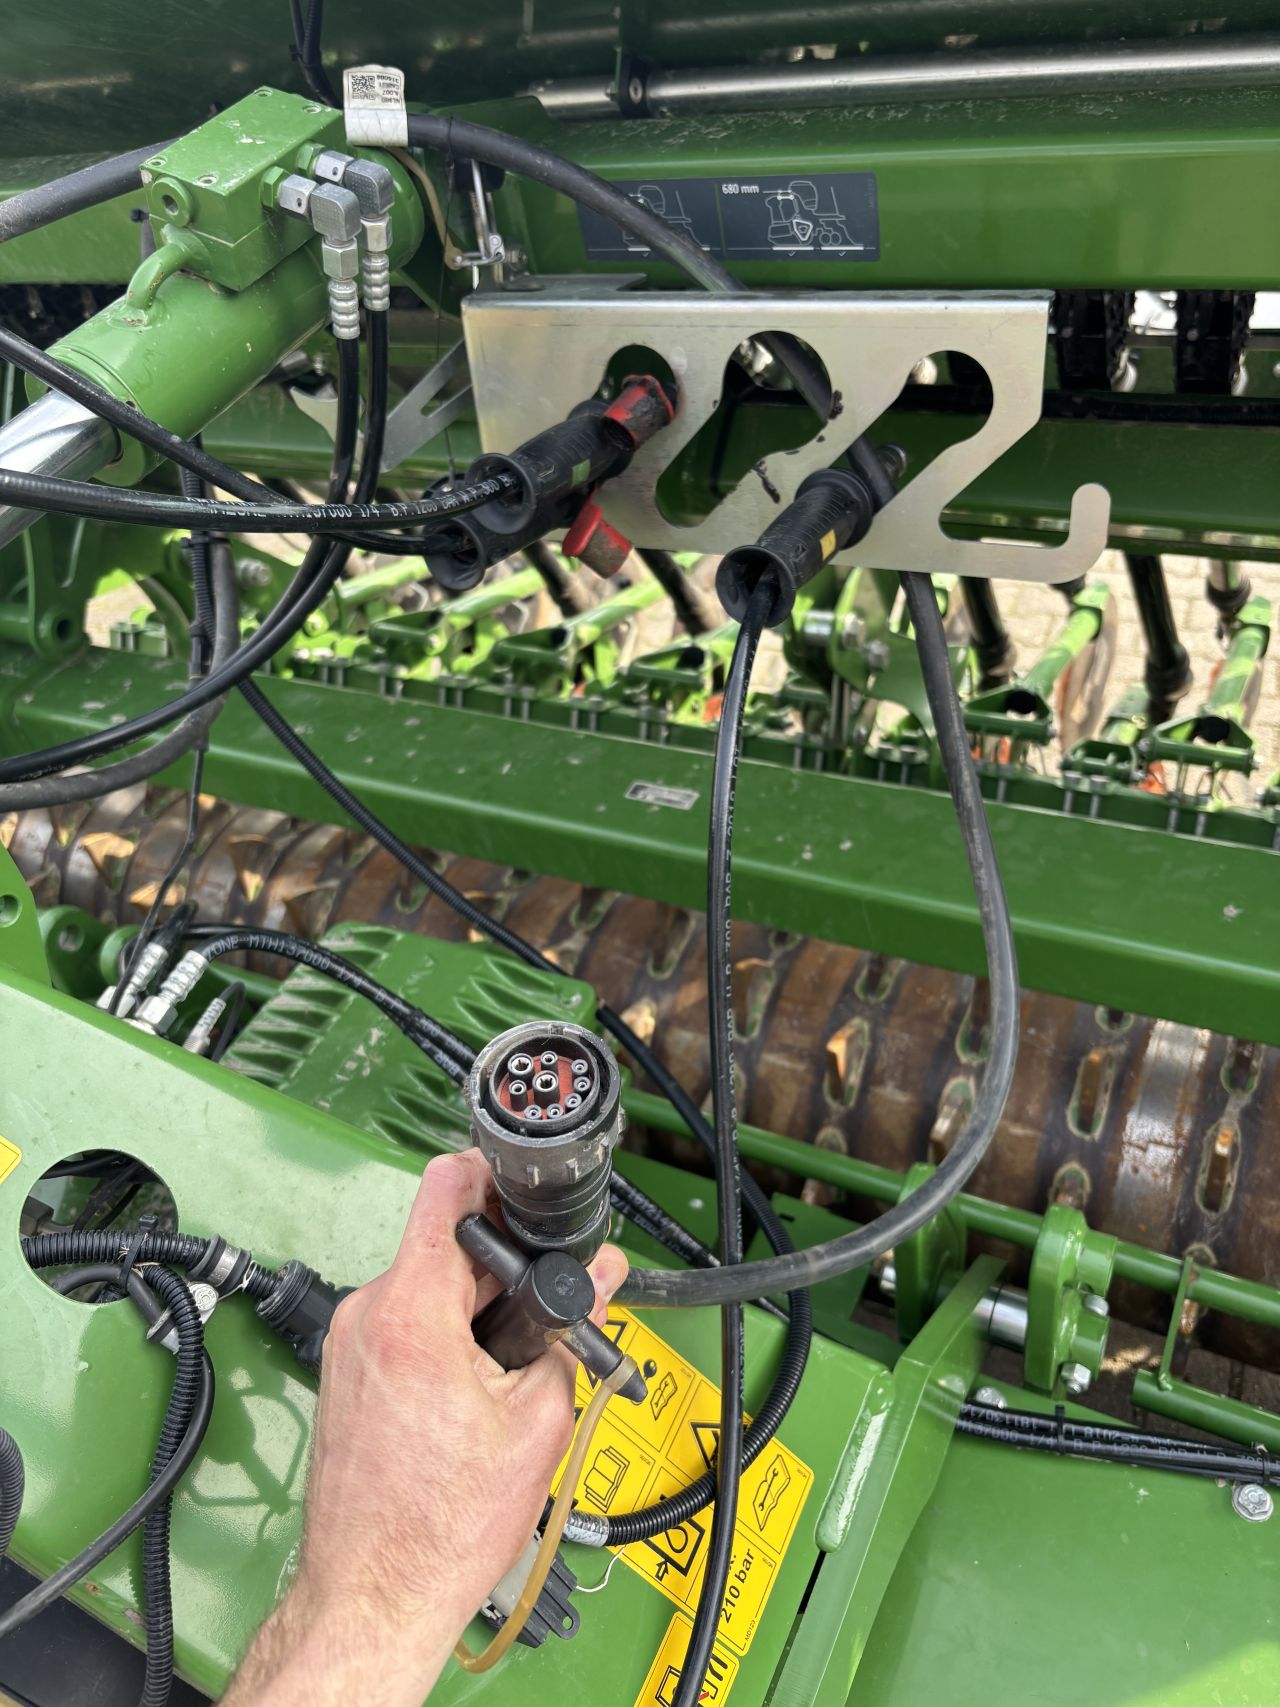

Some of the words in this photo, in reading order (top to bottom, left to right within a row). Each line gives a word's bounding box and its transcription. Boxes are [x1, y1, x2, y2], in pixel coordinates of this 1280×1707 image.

[722, 183, 740, 194] 680
[740, 185, 760, 194] mm
[721, 1586, 741, 1623] 210
[735, 1549, 754, 1583] bar
